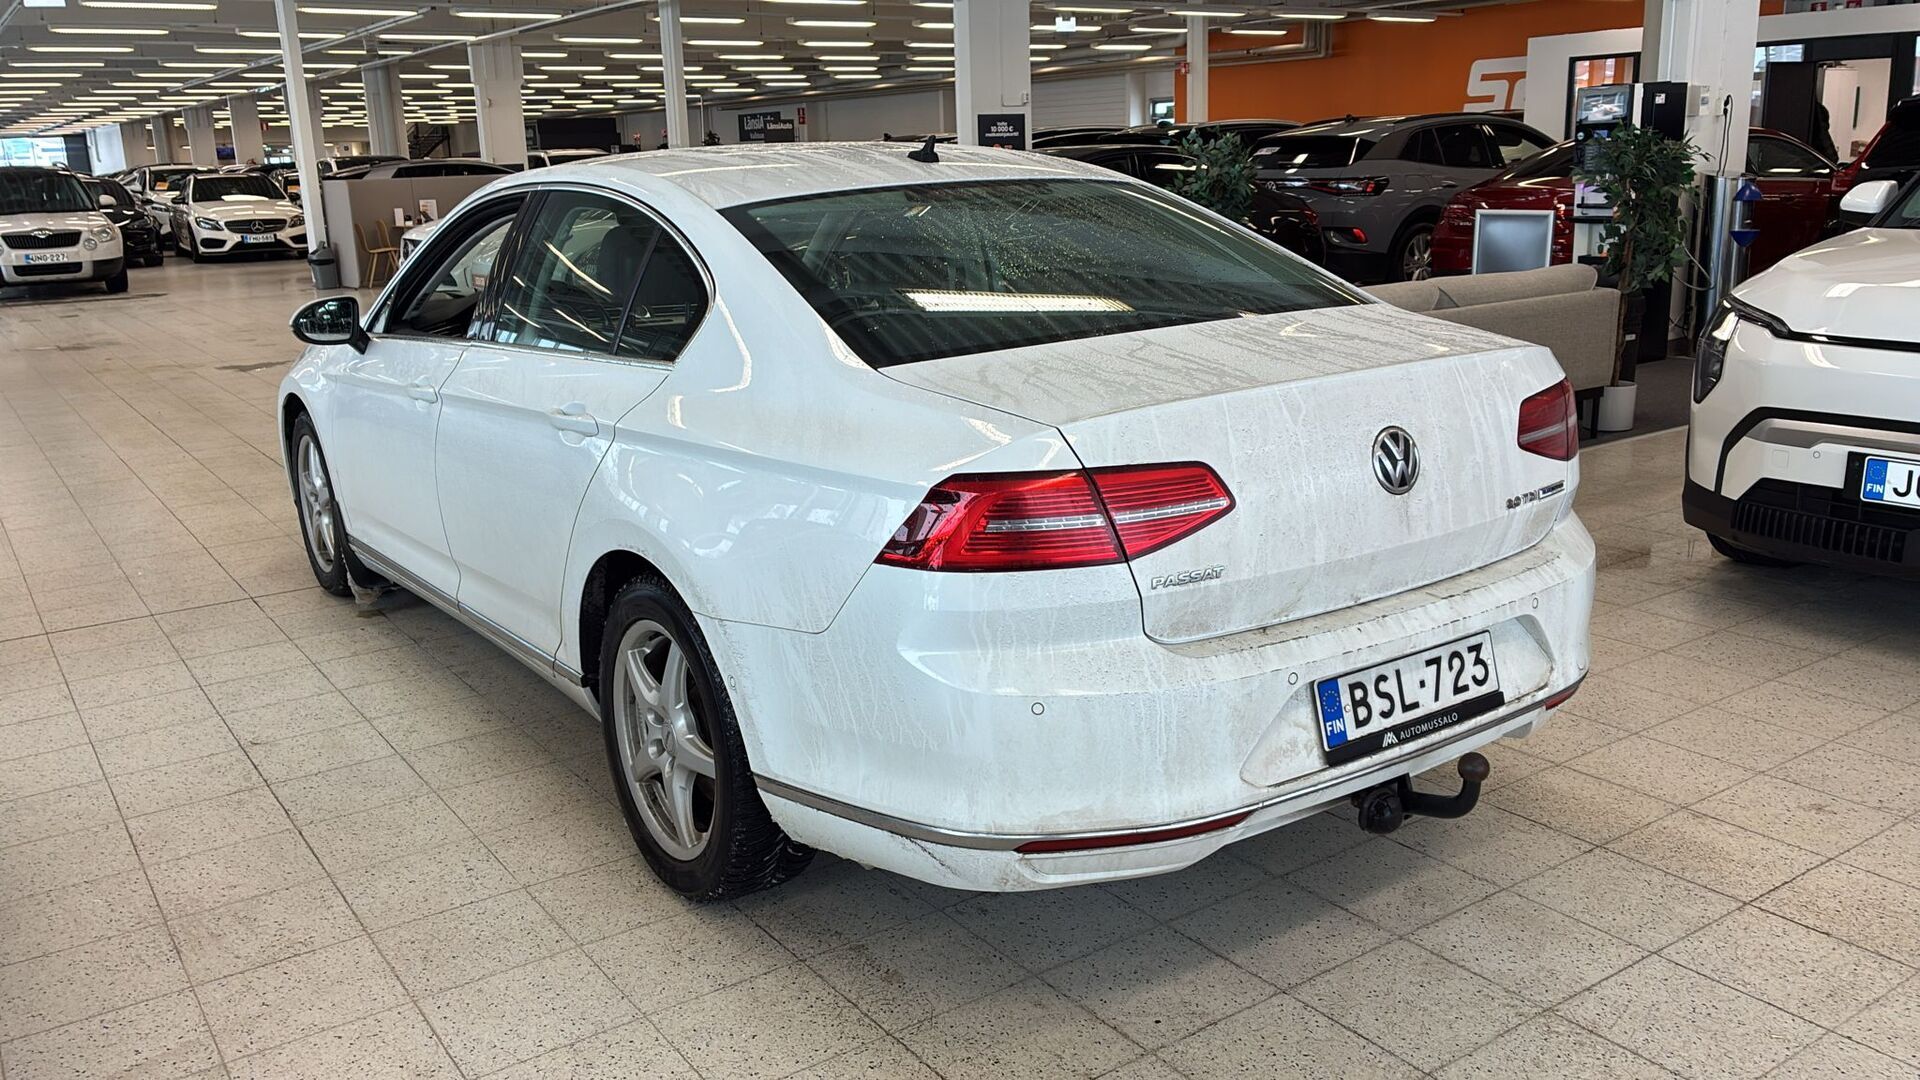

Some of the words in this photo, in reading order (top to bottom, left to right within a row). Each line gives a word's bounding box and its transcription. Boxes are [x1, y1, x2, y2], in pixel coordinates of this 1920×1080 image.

[1866, 483, 1884, 494] FIN
[1150, 565, 1226, 591] PASSAT
[1347, 642, 1490, 730] BSL-723
[1325, 717, 1345, 737] FIN
[1399, 711, 1458, 741] AUTOMUSSALO
